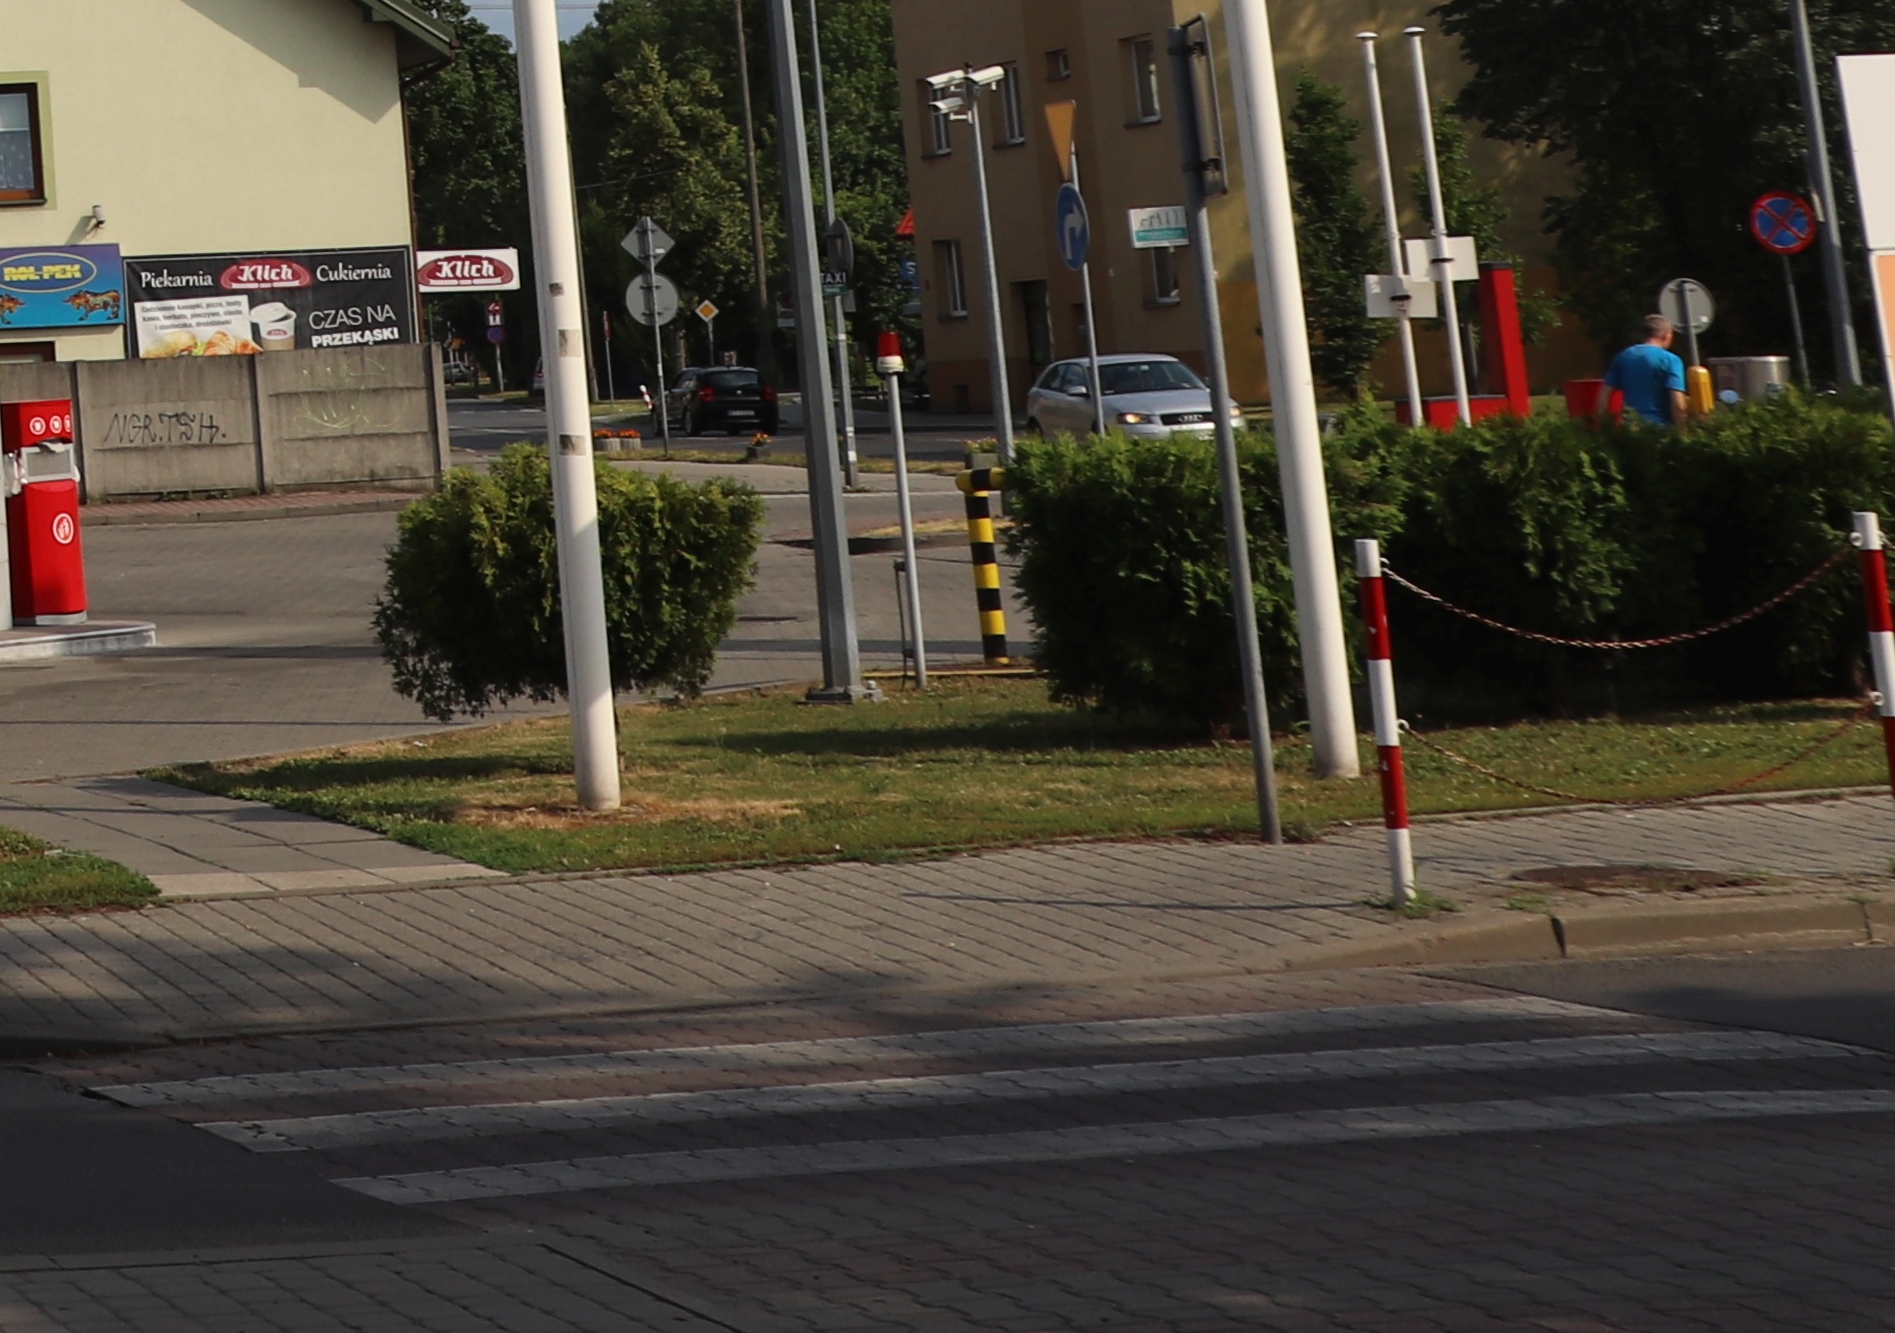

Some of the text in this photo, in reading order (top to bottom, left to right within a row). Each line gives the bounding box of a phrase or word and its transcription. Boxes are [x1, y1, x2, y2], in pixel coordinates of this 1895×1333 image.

[140, 262, 393, 288] Piekarnia Klich Cukiernia
[435, 259, 495, 278] Klich
[309, 304, 397, 329] CZAS NA
[311, 327, 400, 348] PRZEKĄSKI
